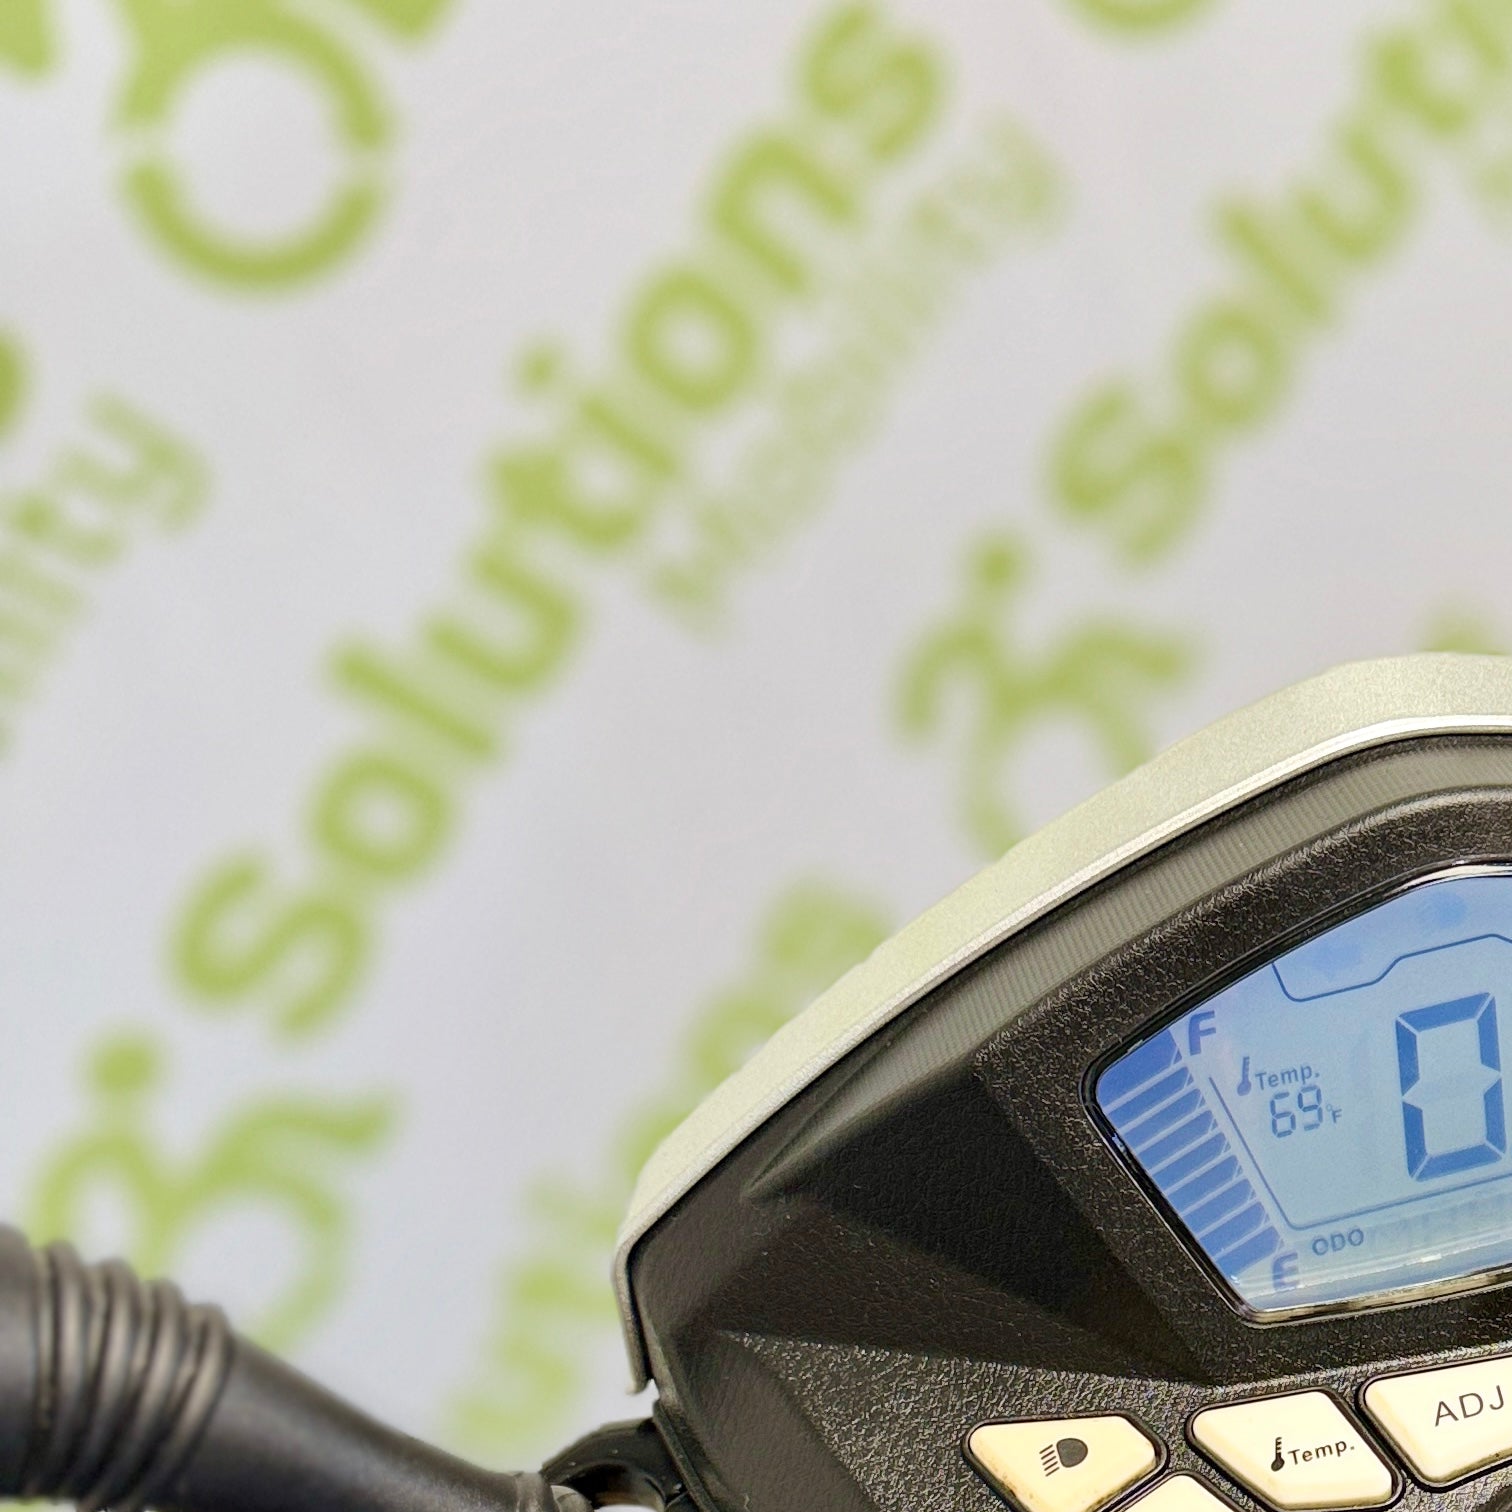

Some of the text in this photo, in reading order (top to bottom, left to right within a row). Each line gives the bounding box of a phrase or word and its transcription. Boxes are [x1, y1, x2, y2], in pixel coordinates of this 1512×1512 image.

[165, 0, 945, 1040] Solutions
[1188, 1010, 1217, 1056] F
[1255, 1064, 1320, 1091] Temp.
[1312, 1227, 1364, 1256] ODO
[1272, 1252, 1299, 1292] E
[1287, 1439, 1355, 1466] Temp.
